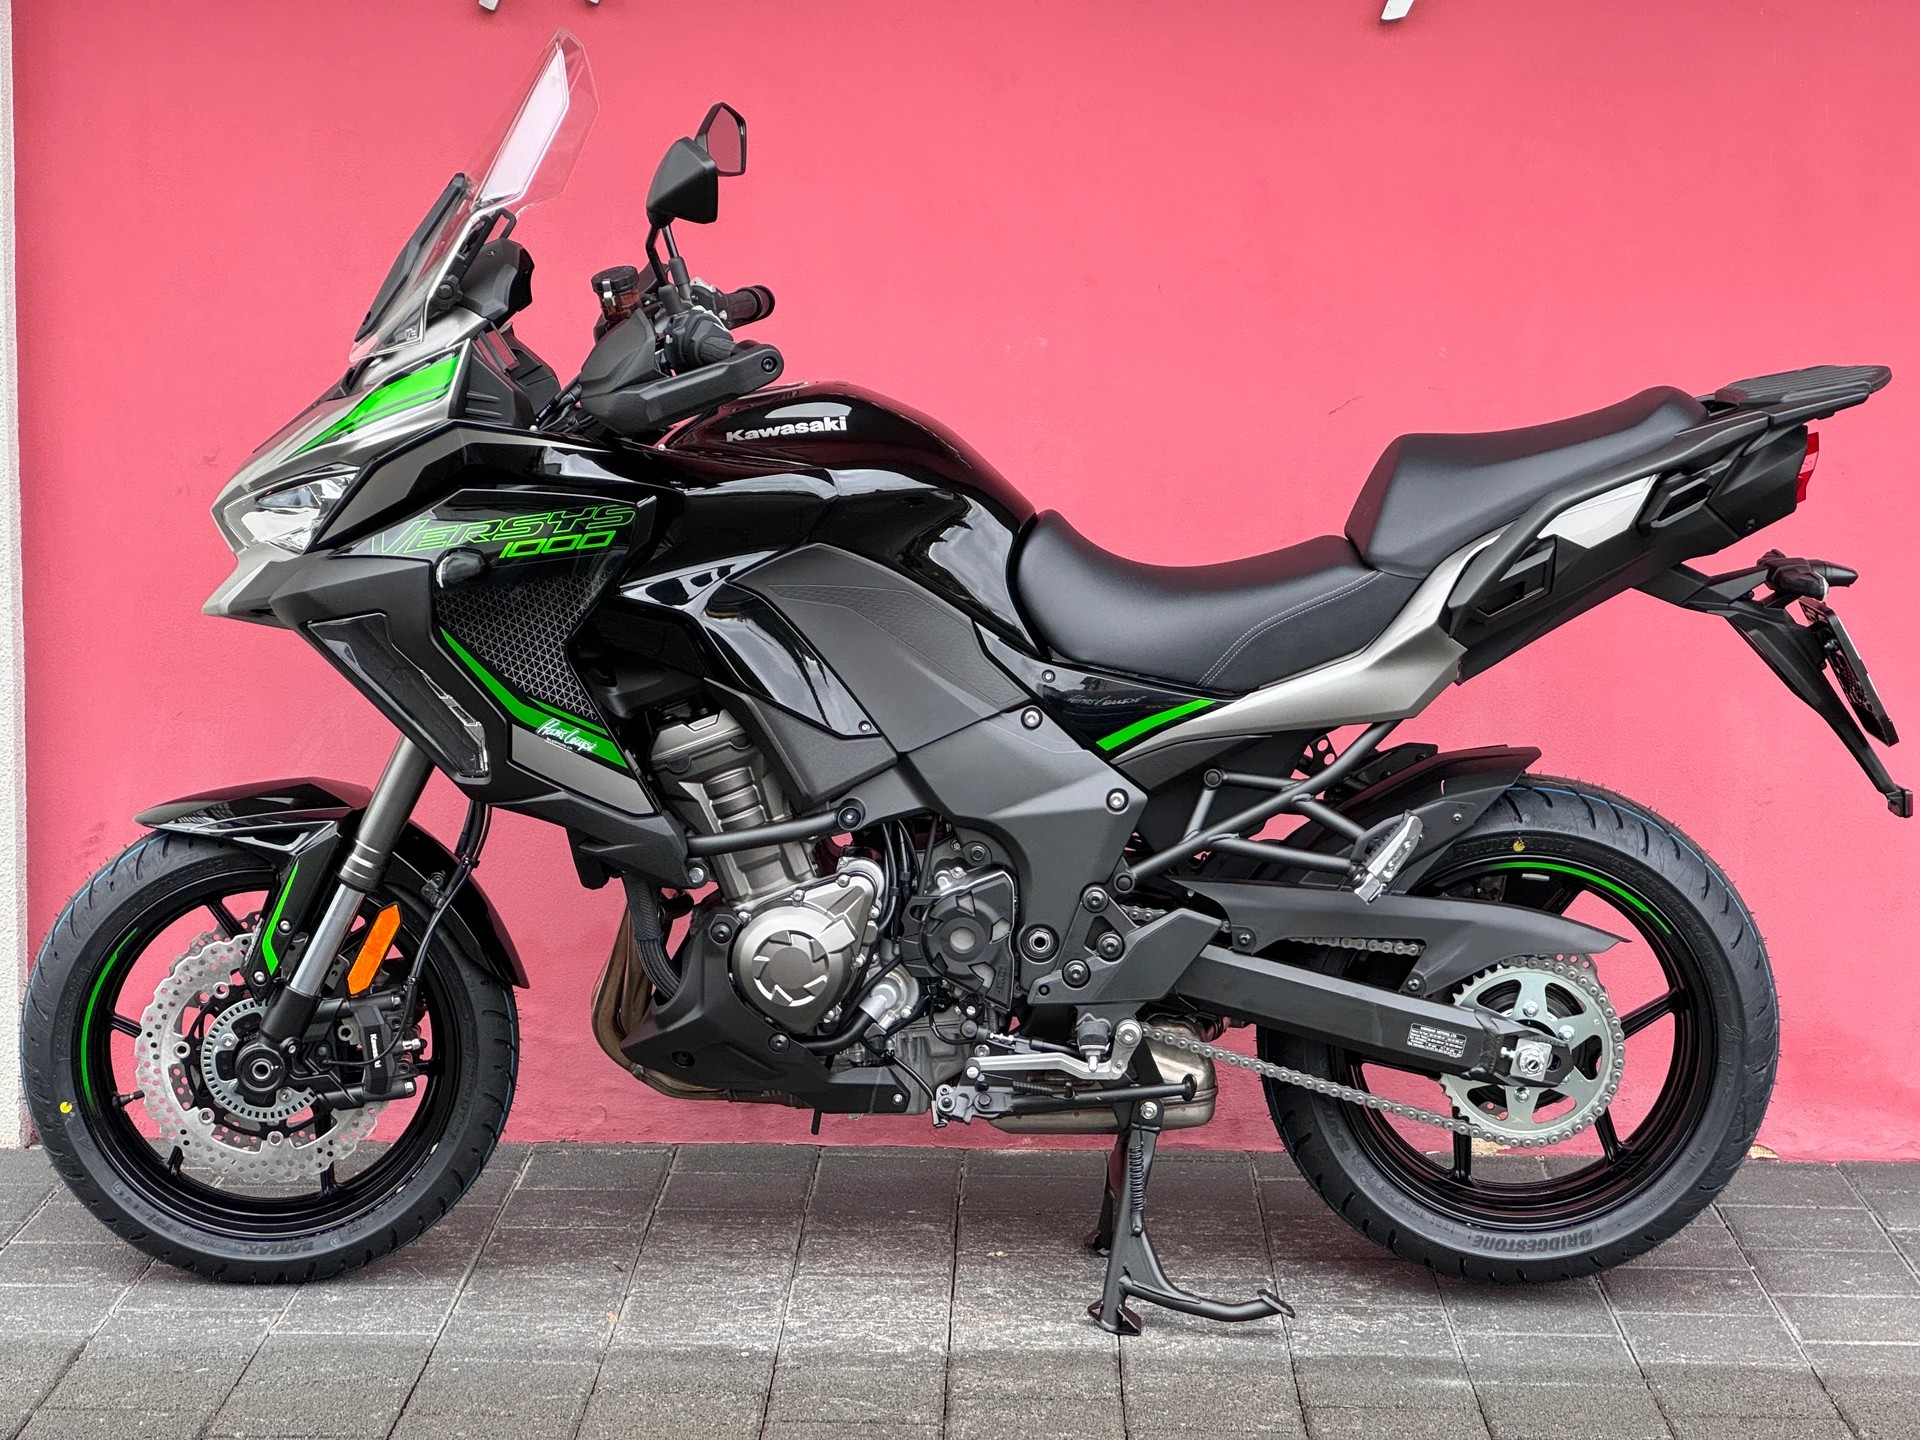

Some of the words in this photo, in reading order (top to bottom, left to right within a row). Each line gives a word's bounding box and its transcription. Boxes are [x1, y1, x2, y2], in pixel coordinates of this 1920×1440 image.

[726, 415, 848, 442] Kawasaki
[371, 504, 636, 554] VERSYS
[499, 530, 616, 559] 1000
[1471, 1228, 1593, 1253] BRIDGESTONE
